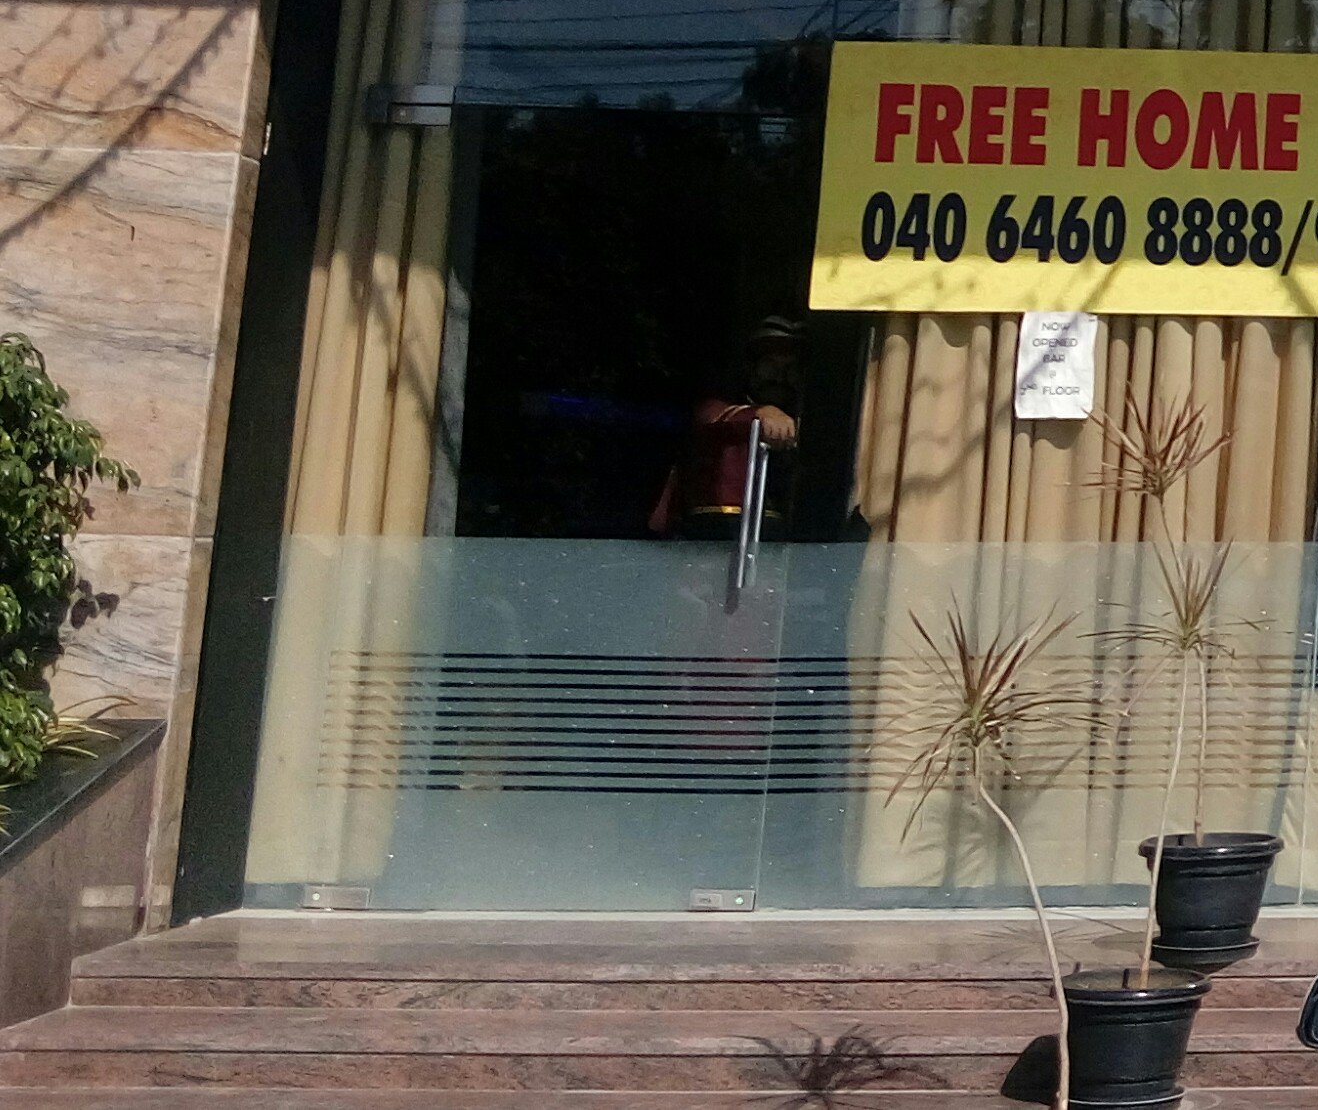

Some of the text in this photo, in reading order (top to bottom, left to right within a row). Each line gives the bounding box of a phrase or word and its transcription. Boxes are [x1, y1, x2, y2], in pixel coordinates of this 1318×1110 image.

[874, 82, 1049, 166] FREE
[1077, 87, 1302, 171] HOME
[861, 191, 968, 263] 040
[986, 194, 1127, 266] 6460
[1041, 386, 1081, 396] FLOOR
